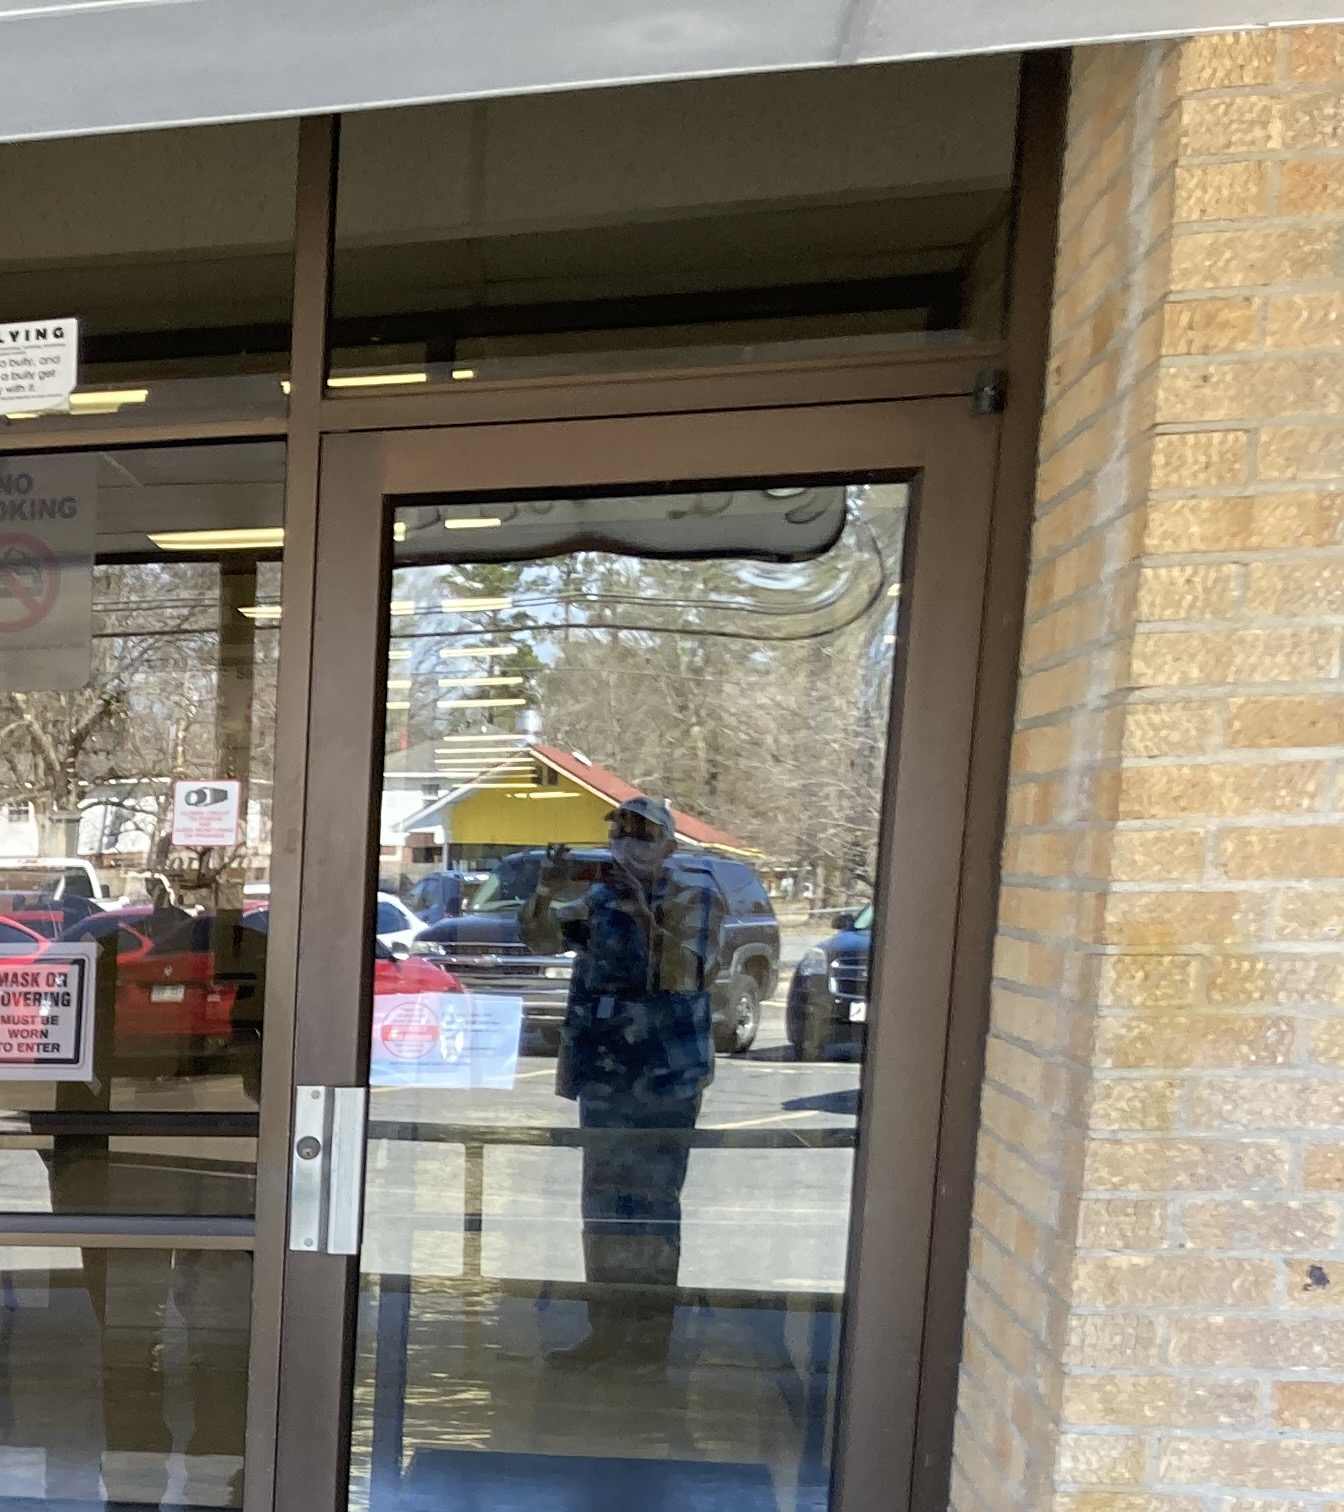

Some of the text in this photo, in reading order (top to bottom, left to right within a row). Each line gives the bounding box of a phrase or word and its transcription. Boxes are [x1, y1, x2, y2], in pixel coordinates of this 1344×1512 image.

[38, 356, 61, 365] and
[0, 372, 9, 382] a
[11, 370, 35, 381] bully
[38, 369, 56, 381] get
[5, 384, 26, 393] with
[45, 971, 68, 988] OR
[0, 1014, 60, 1026] MUST BE
[7, 1028, 49, 1039] WORN
[16, 1042, 61, 1053] ENTER
